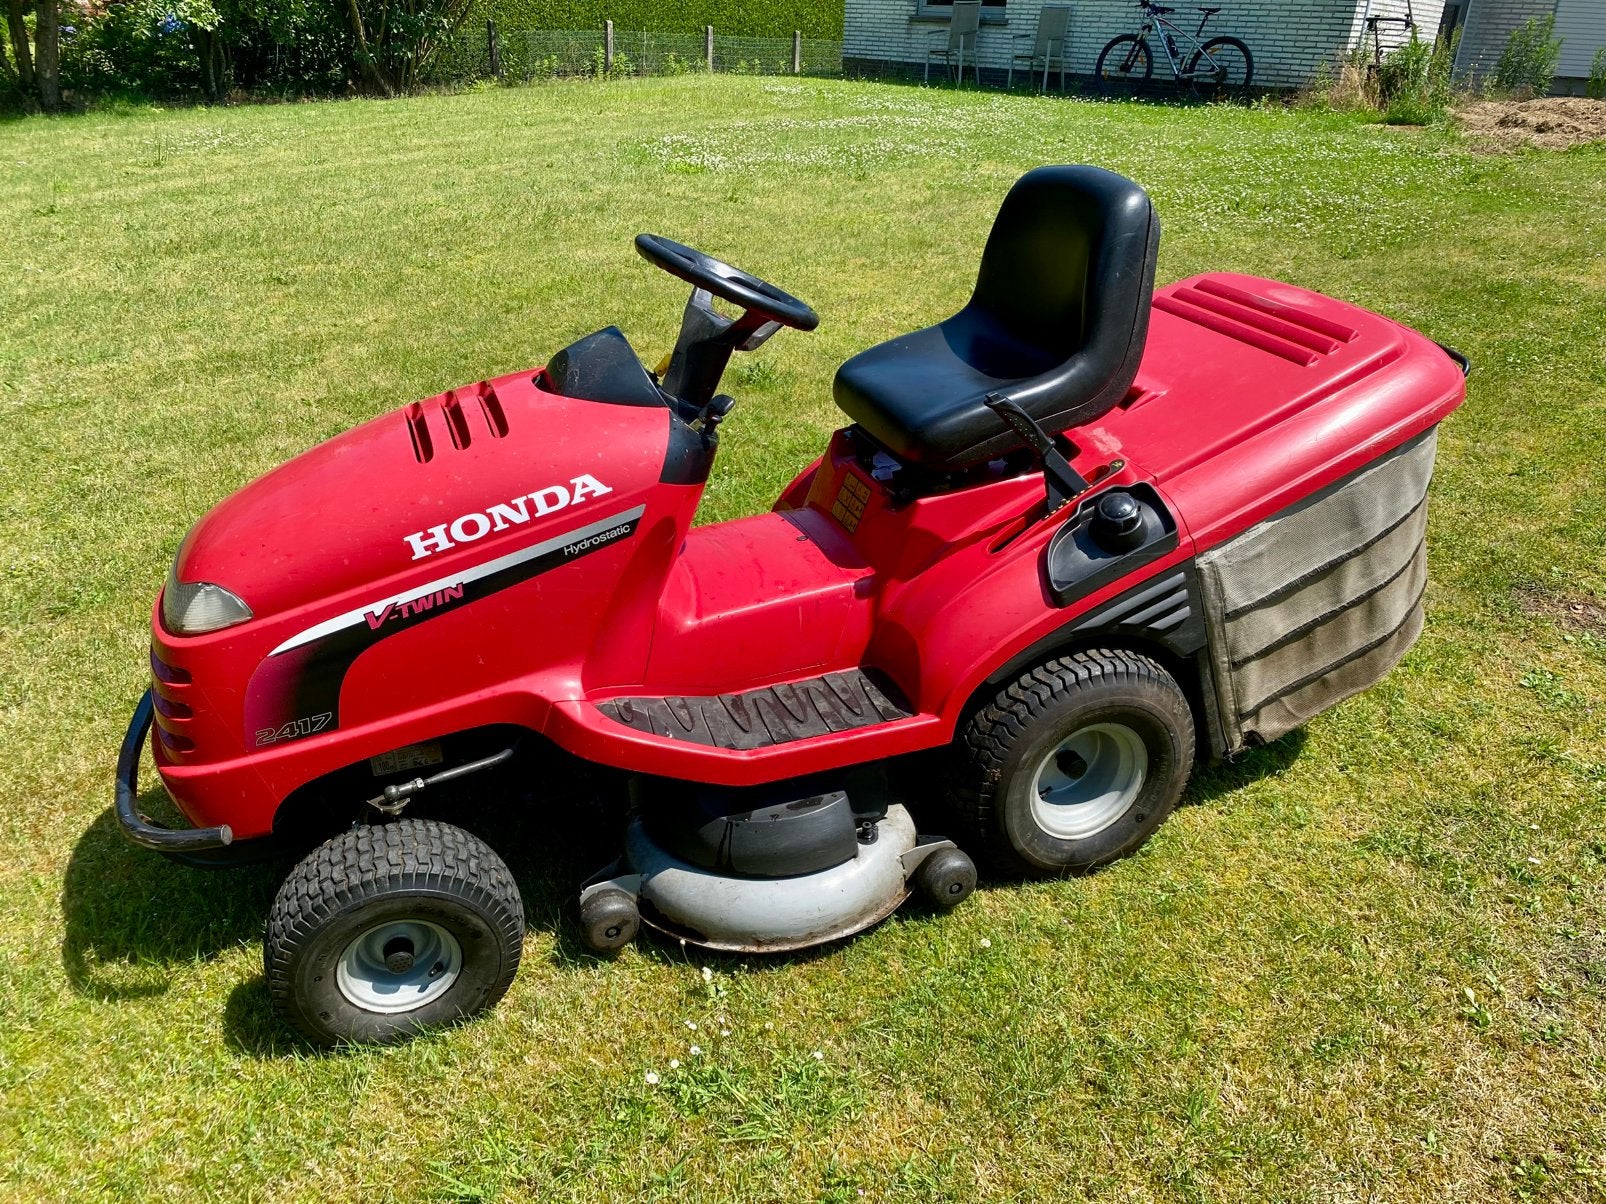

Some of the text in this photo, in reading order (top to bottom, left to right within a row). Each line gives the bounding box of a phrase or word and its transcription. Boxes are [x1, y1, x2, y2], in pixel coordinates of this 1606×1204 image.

[403, 473, 613, 560] HONDA
[563, 524, 631, 556] Hydrostatic
[363, 582, 464, 630] V-TWIN
[255, 712, 332, 747] 2417
